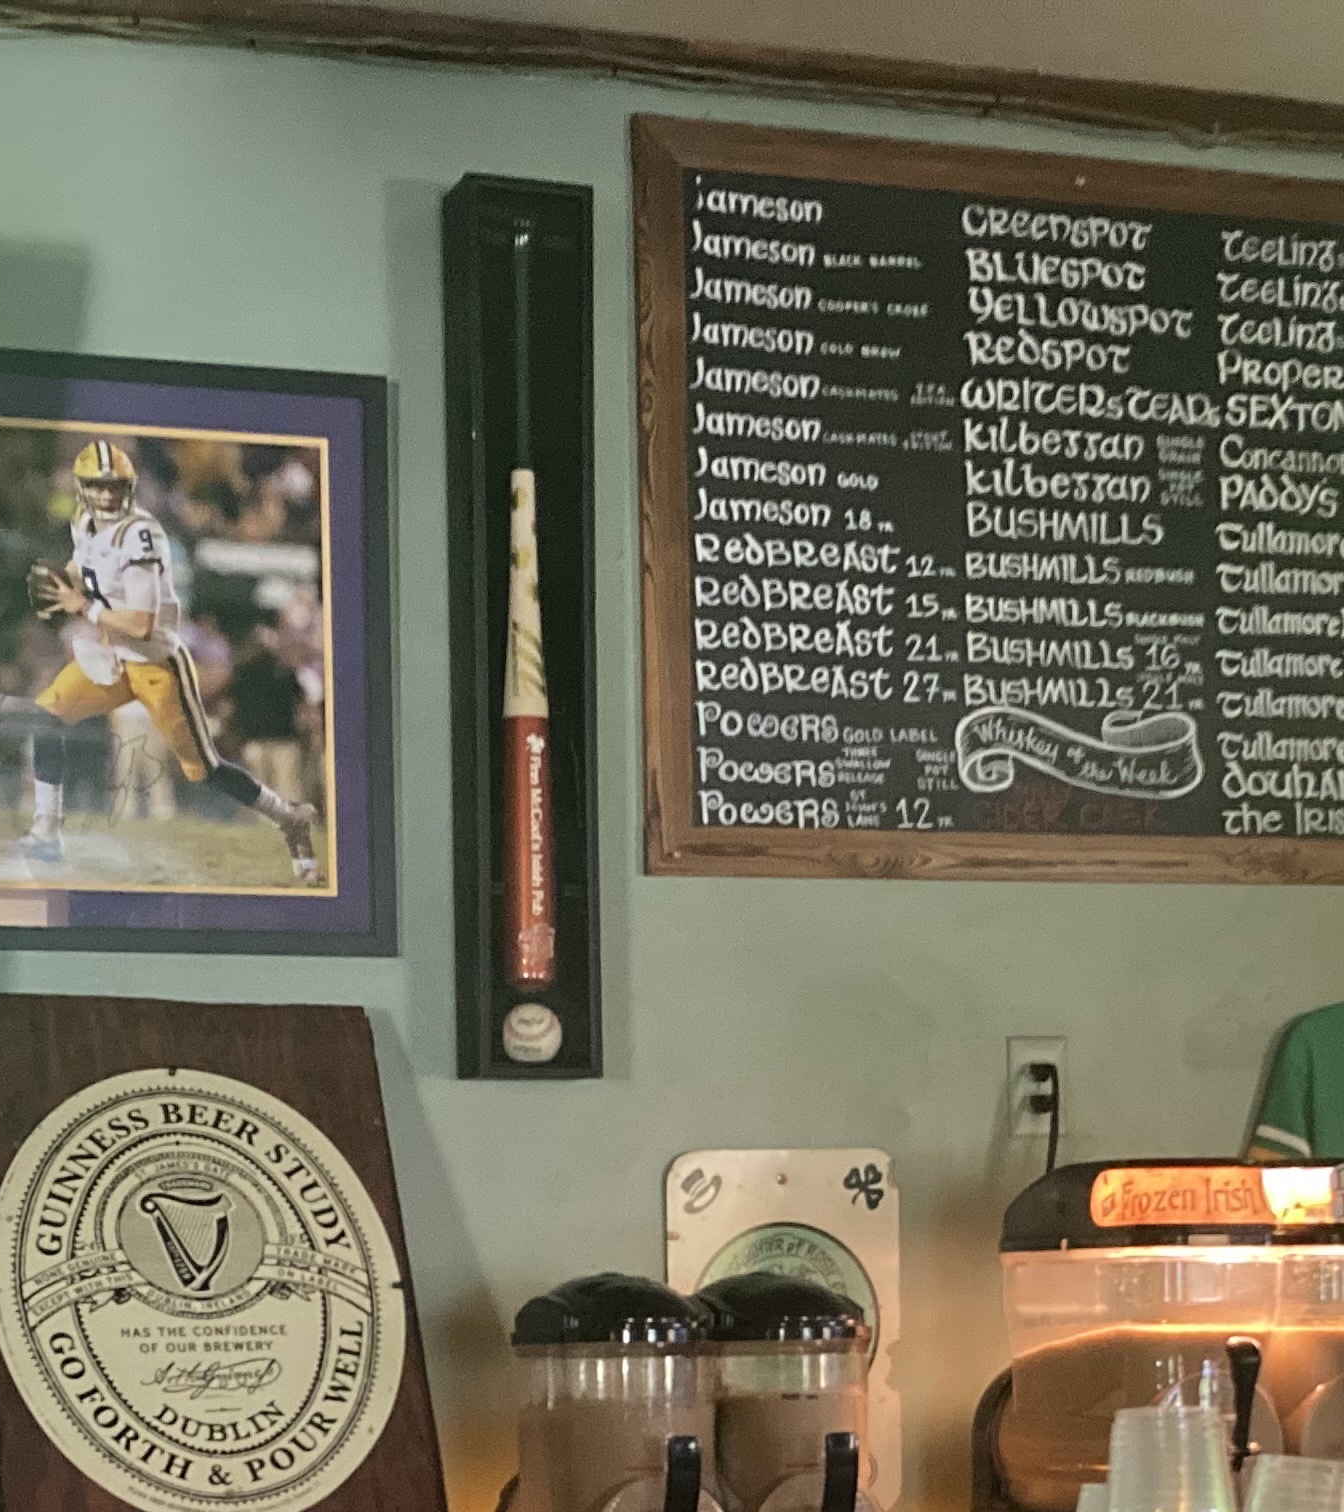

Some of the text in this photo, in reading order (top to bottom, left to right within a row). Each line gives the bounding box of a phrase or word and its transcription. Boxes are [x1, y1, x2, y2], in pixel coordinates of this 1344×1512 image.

[691, 219, 815, 267] Jameson
[690, 267, 812, 310] Jameson
[690, 311, 814, 355] Jameson
[690, 356, 820, 399] Jameson
[693, 402, 821, 442] Jameson
[695, 446, 879, 491] Jameson GOLD
[694, 487, 831, 528] Jameson
[845, 508, 872, 532] 18
[966, 500, 1165, 546] BUSHMILLS
[138, 528, 154, 552] 9
[906, 553, 937, 578] 12
[965, 551, 1121, 585] BUSHMILLS
[906, 593, 939, 618] 15
[965, 592, 1124, 628] BUSHMILLS
[1215, 604, 1341, 638] Tullamore
[905, 633, 943, 661] 21
[966, 630, 1135, 670] BUSHMILLS
[1145, 643, 1181, 671] 16
[1215, 647, 1344, 680] Tullamore
[903, 670, 941, 703] 27
[963, 673, 1135, 708] BUSHMILLS
[1141, 680, 1184, 711] 21
[842, 727, 883, 743] GOLD
[890, 727, 938, 744] LABEL
[1112, 756, 1178, 784] Week
[896, 797, 933, 829] 12
[531, 889, 545, 917] Pub
[36, 1102, 352, 1257] GUINNESS BEER STUDY
[1120, 1176, 1256, 1223] Frozen Irish
[120, 1324, 288, 1339] HAS THE CONFIDENCE
[138, 1339, 274, 1354] OF OUR BREWERY
[49, 1331, 86, 1381] GO
[75, 1384, 195, 1481] FORTH
[207, 1463, 234, 1487] &
[243, 1409, 340, 1483] POUR
[323, 1320, 364, 1405] WELL
[154, 1400, 287, 1443] DUBLIN
